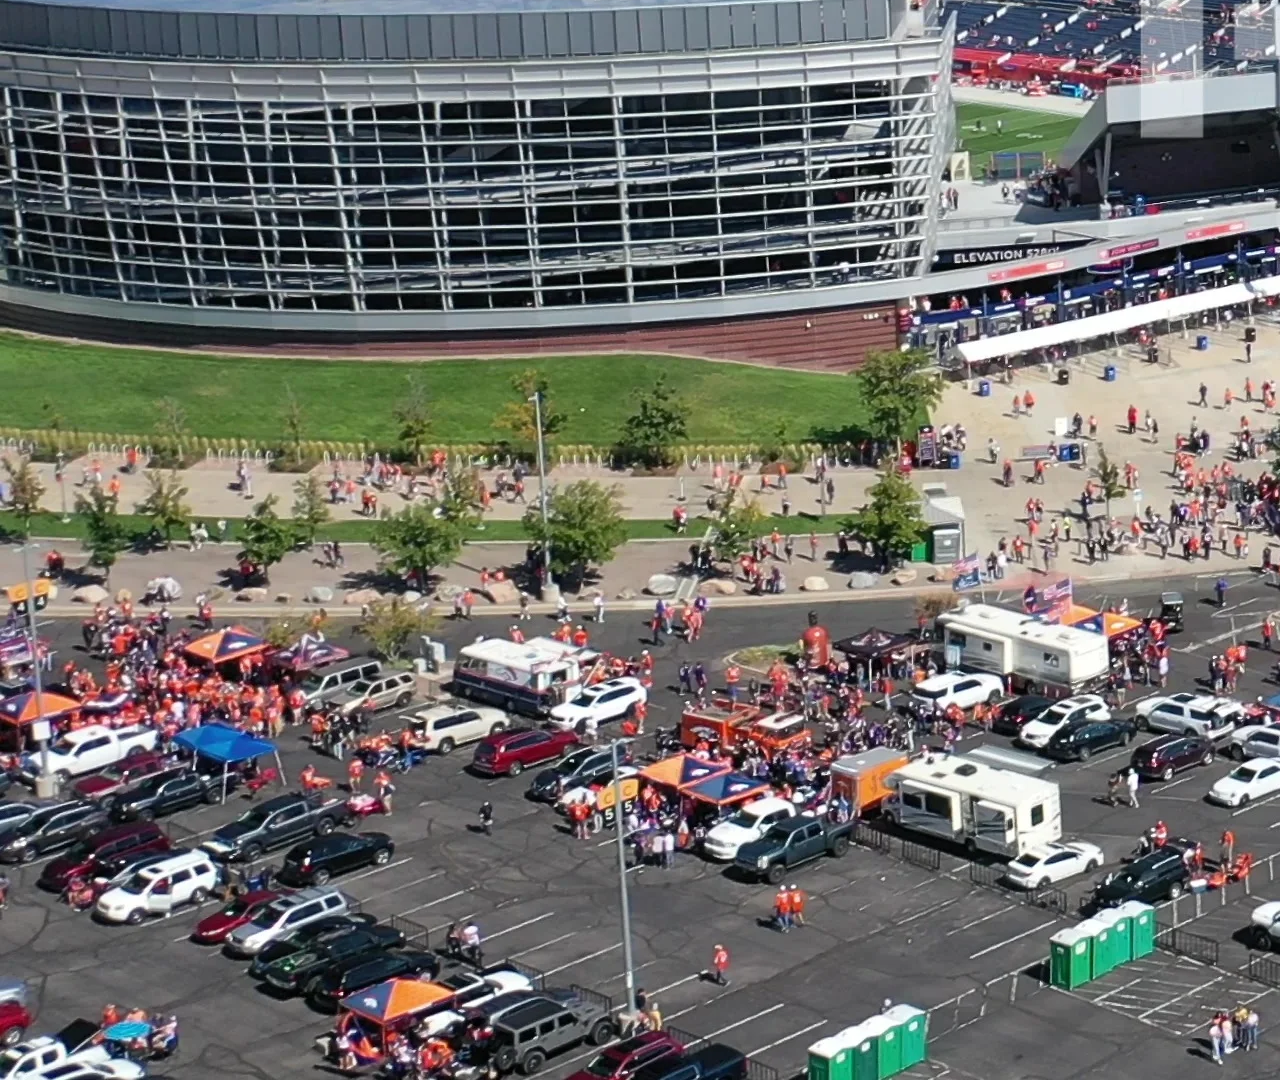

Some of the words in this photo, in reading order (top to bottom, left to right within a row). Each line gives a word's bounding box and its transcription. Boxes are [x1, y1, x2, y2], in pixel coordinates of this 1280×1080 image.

[954, 249, 1023, 264] ELEVATION
[624, 800, 633, 812] 5
[605, 808, 614, 820] 5
